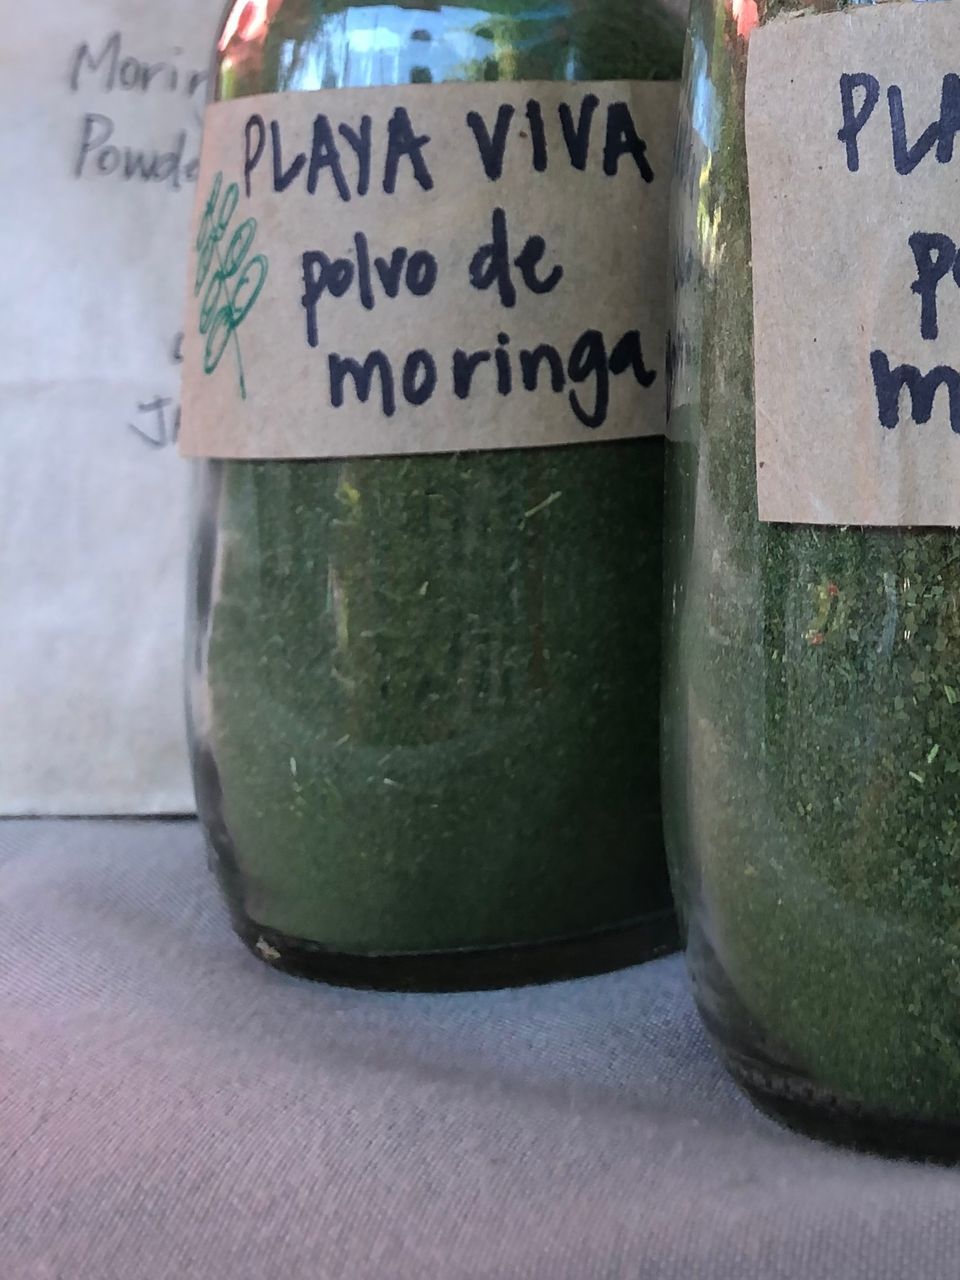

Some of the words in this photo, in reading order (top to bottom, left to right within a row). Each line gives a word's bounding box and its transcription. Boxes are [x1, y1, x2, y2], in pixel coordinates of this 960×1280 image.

[245, 107, 435, 201] PLAYA
[466, 94, 656, 183] VIVA
[302, 232, 438, 347] polvo
[469, 207, 564, 308] de
[328, 329, 657, 428] moringa
